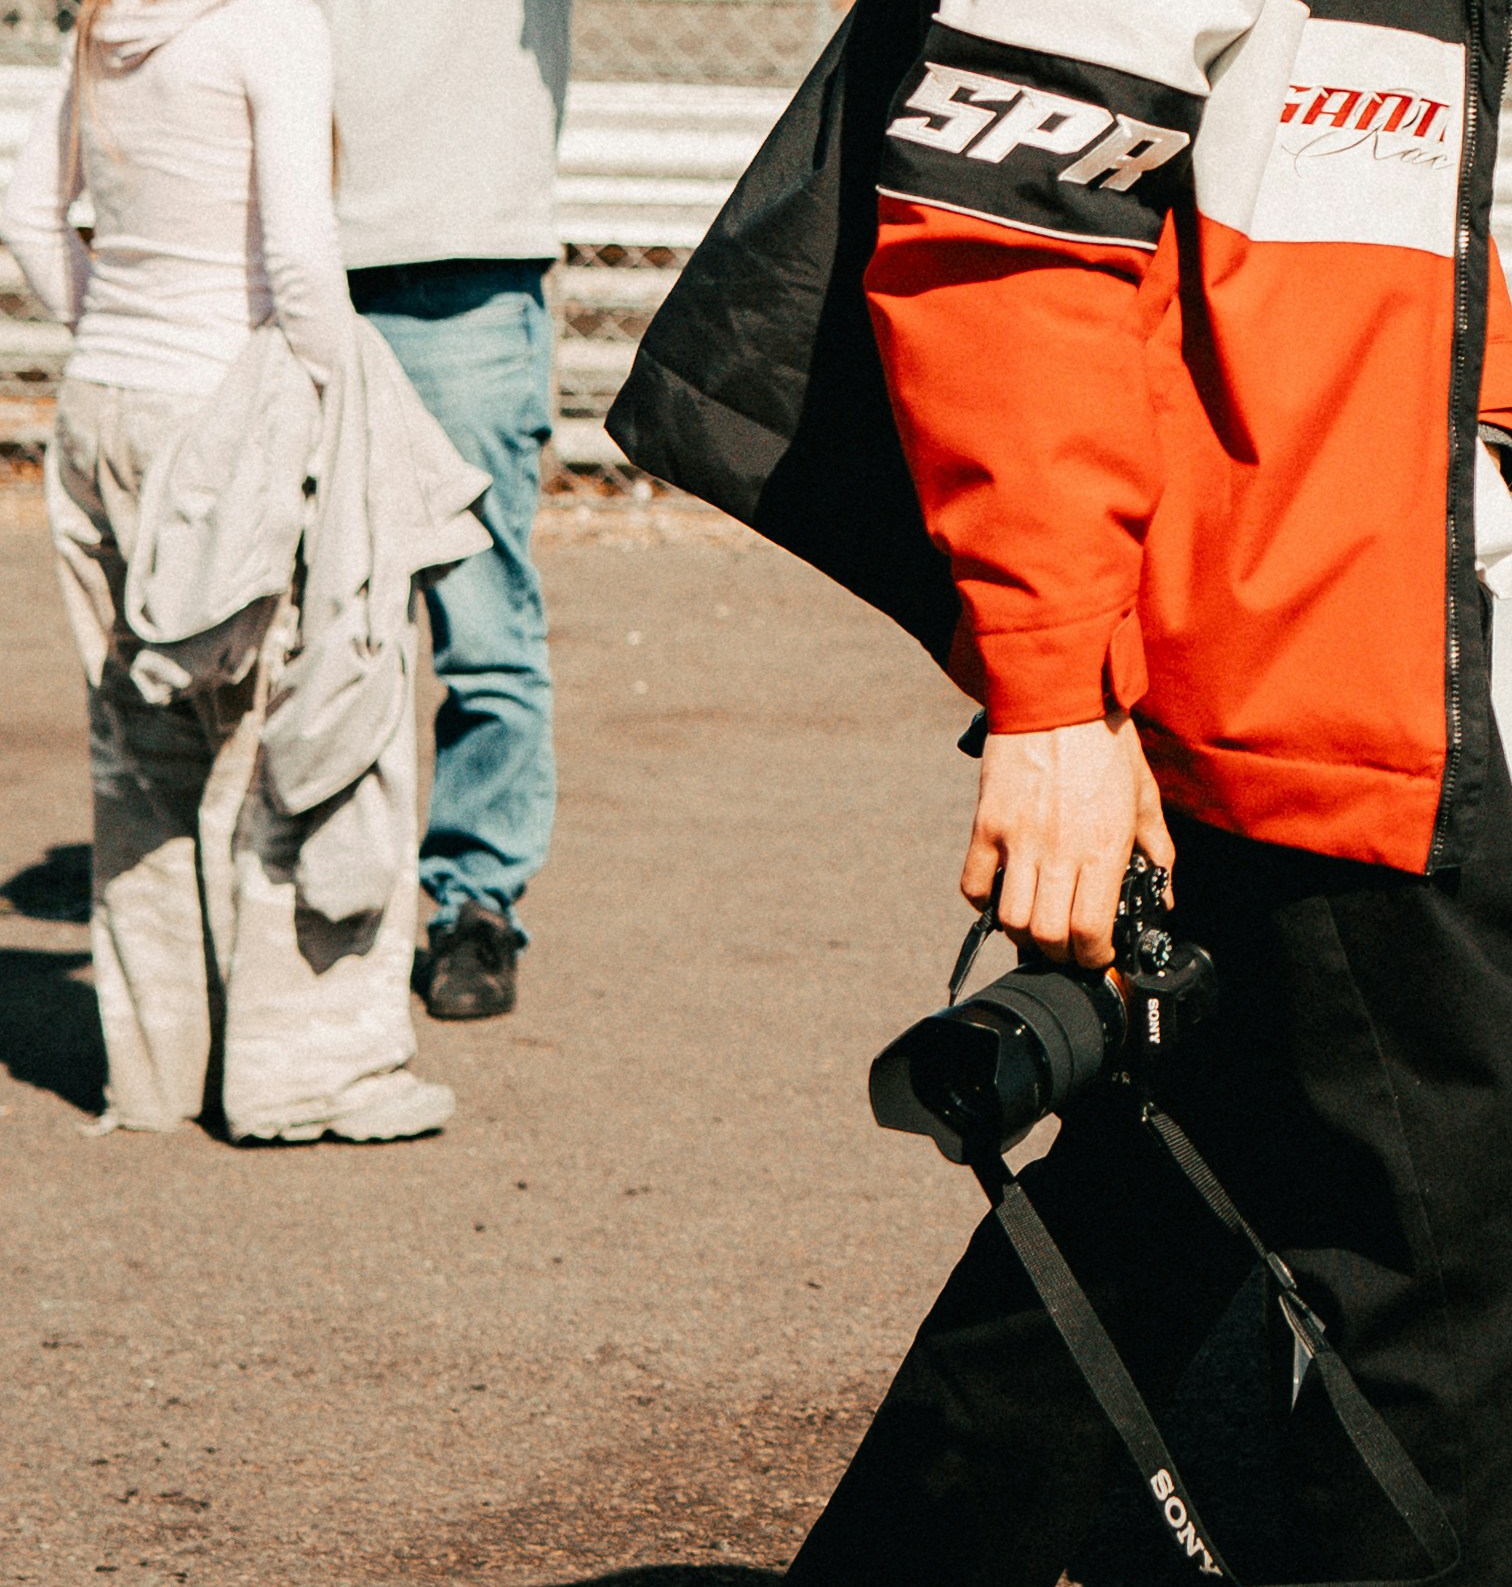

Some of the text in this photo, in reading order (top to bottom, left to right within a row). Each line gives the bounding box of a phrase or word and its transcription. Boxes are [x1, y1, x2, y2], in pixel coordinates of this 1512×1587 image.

[1280, 84, 1450, 142] ANT
[1148, 997, 1160, 1044] SONY
[1150, 1468, 1223, 1576] SONY
